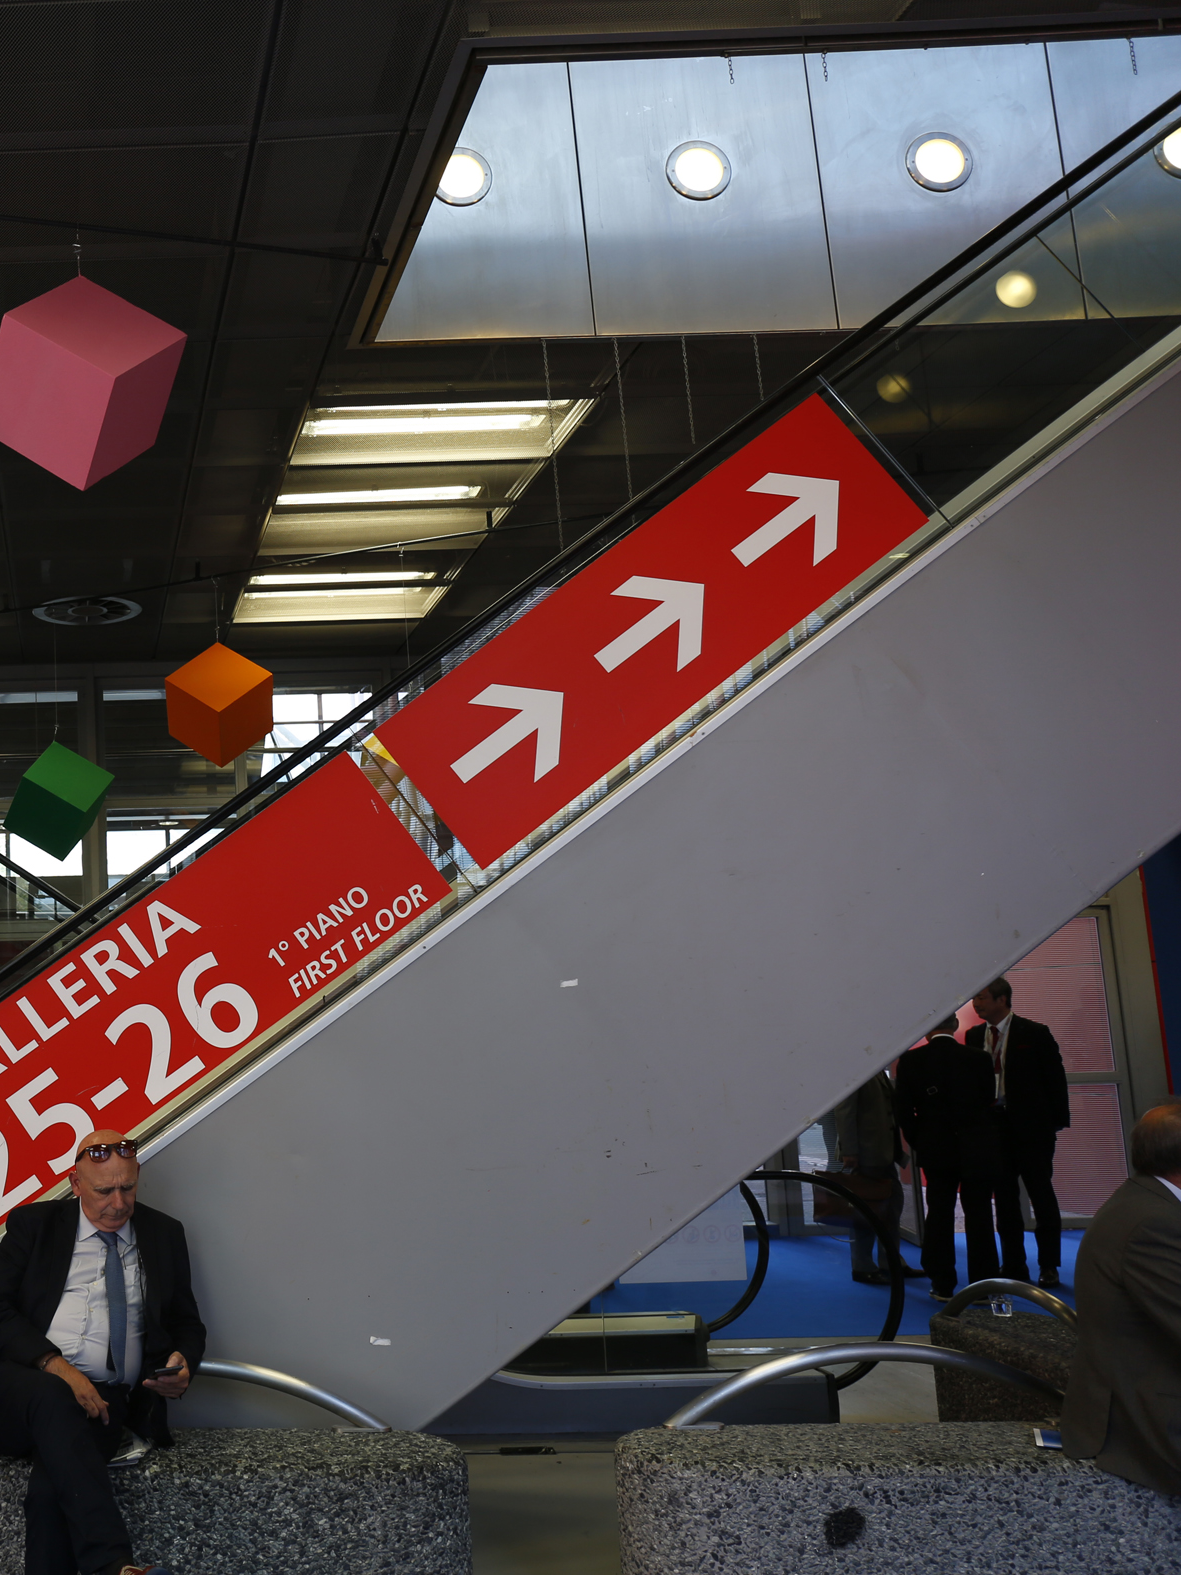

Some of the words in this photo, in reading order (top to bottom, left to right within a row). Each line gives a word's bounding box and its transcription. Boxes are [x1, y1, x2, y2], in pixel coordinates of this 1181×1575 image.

[268, 940, 289, 967] 1°
[293, 886, 369, 950] PIANO
[288, 938, 348, 999] FIRST
[350, 884, 429, 951] FLOOR
